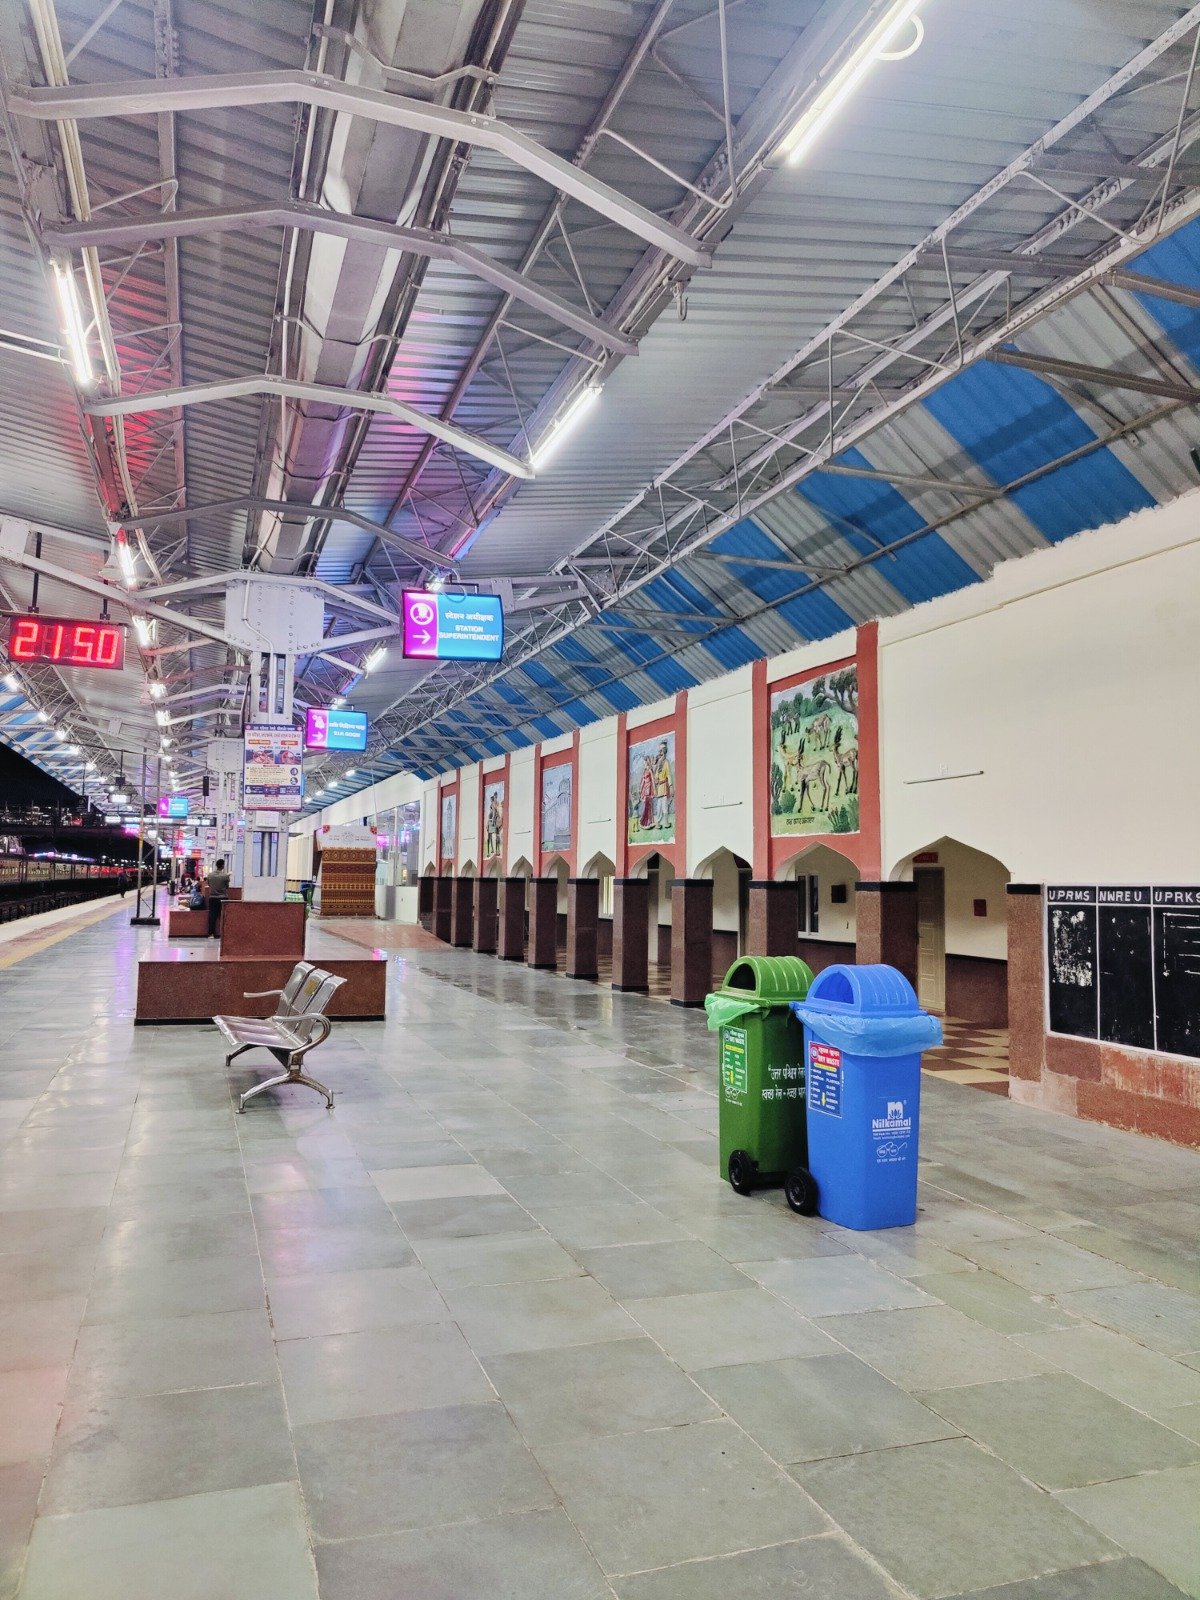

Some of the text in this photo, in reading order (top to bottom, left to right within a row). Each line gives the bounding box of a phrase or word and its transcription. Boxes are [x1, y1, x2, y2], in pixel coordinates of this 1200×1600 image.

[439, 632, 499, 642] SUPERINTENDENT
[1048, 890, 1090, 902] UPRMS
[872, 1117, 911, 1128] Nilkamal
